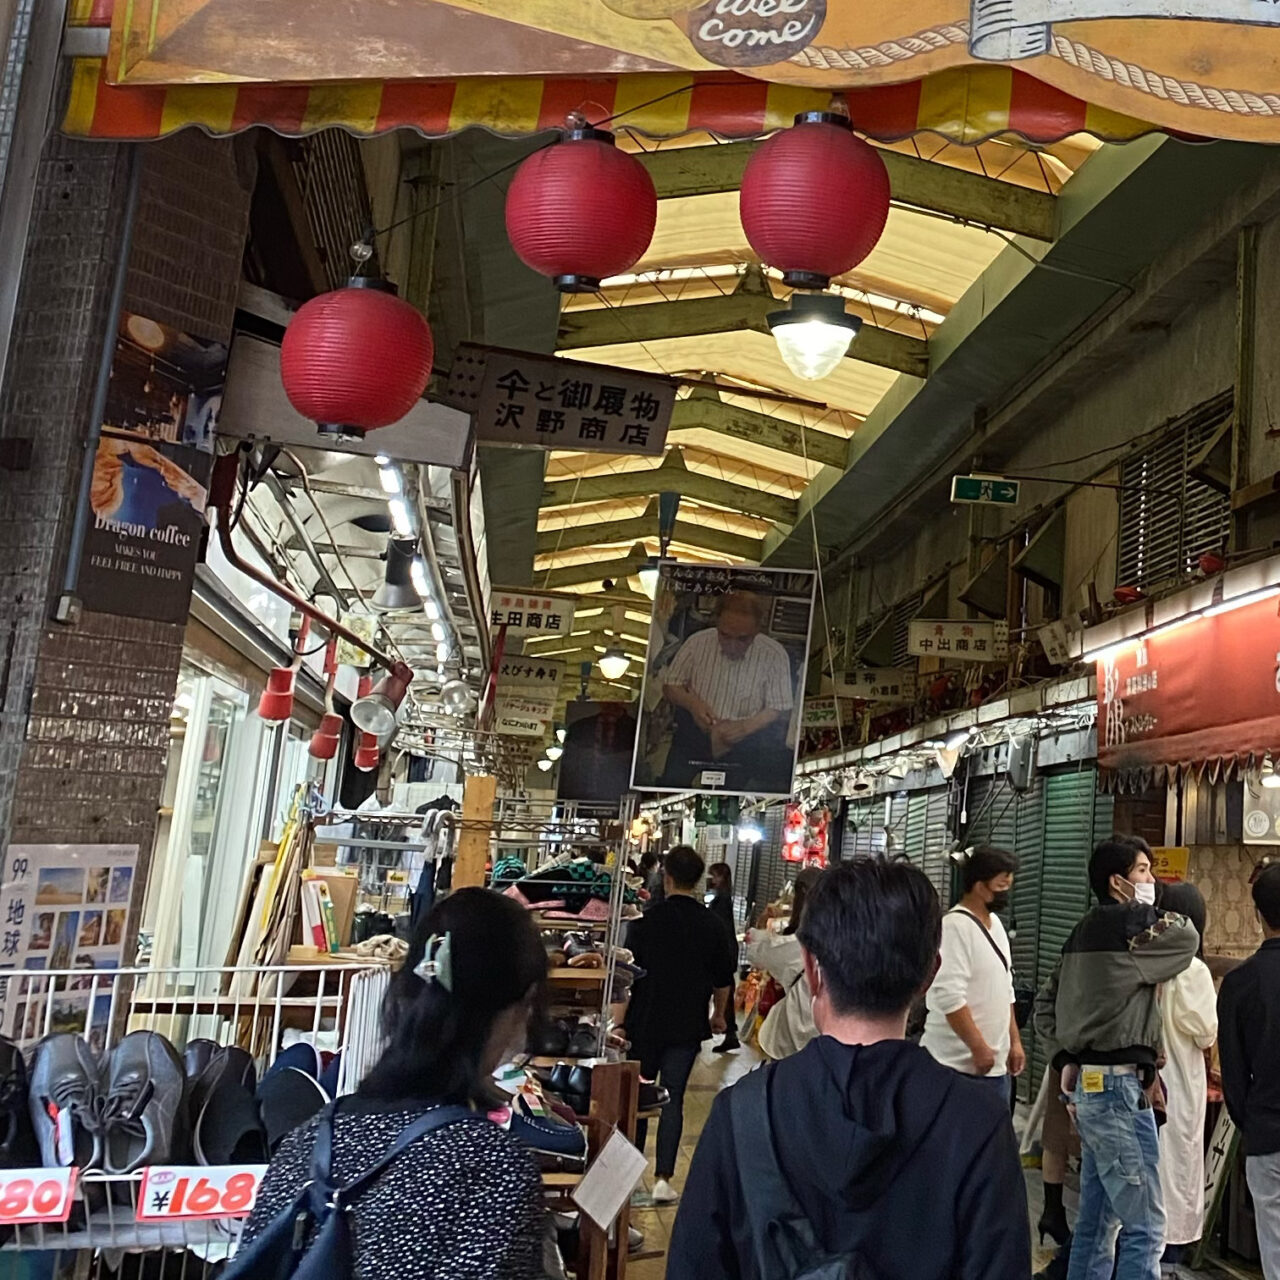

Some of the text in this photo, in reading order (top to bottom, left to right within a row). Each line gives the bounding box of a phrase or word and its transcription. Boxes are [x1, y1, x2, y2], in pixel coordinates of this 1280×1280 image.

[700, 14, 816, 48] come
[495, 402, 650, 447] 沢野商店
[94, 518, 191, 548] Dragon coffee
